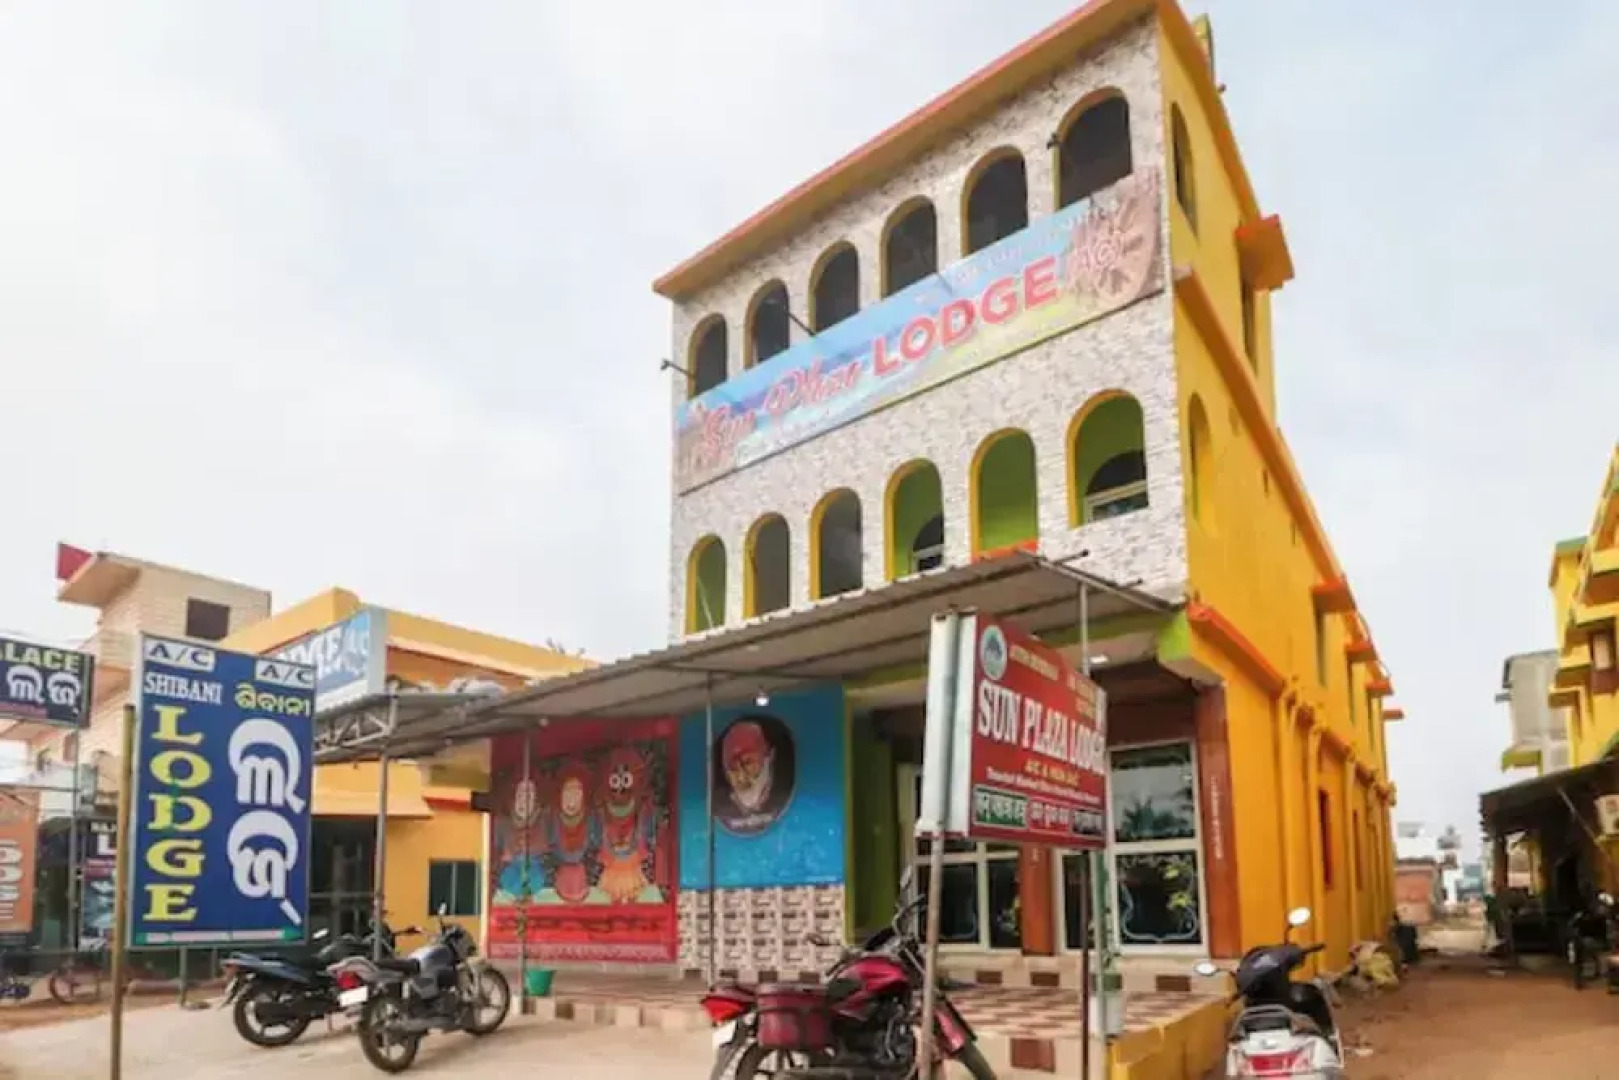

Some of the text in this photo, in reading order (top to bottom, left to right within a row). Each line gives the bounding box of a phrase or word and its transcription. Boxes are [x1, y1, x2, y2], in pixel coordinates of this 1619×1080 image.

[873, 255, 1058, 376] LODGE
[0, 642, 79, 673] LACE
[149, 643, 210, 668] A/C
[145, 674, 222, 704] SHIBANI
[260, 664, 312, 685] A/C
[979, 680, 1020, 744] SUN
[1022, 698, 1068, 761] PLAZA
[142, 704, 213, 921] LODGE
